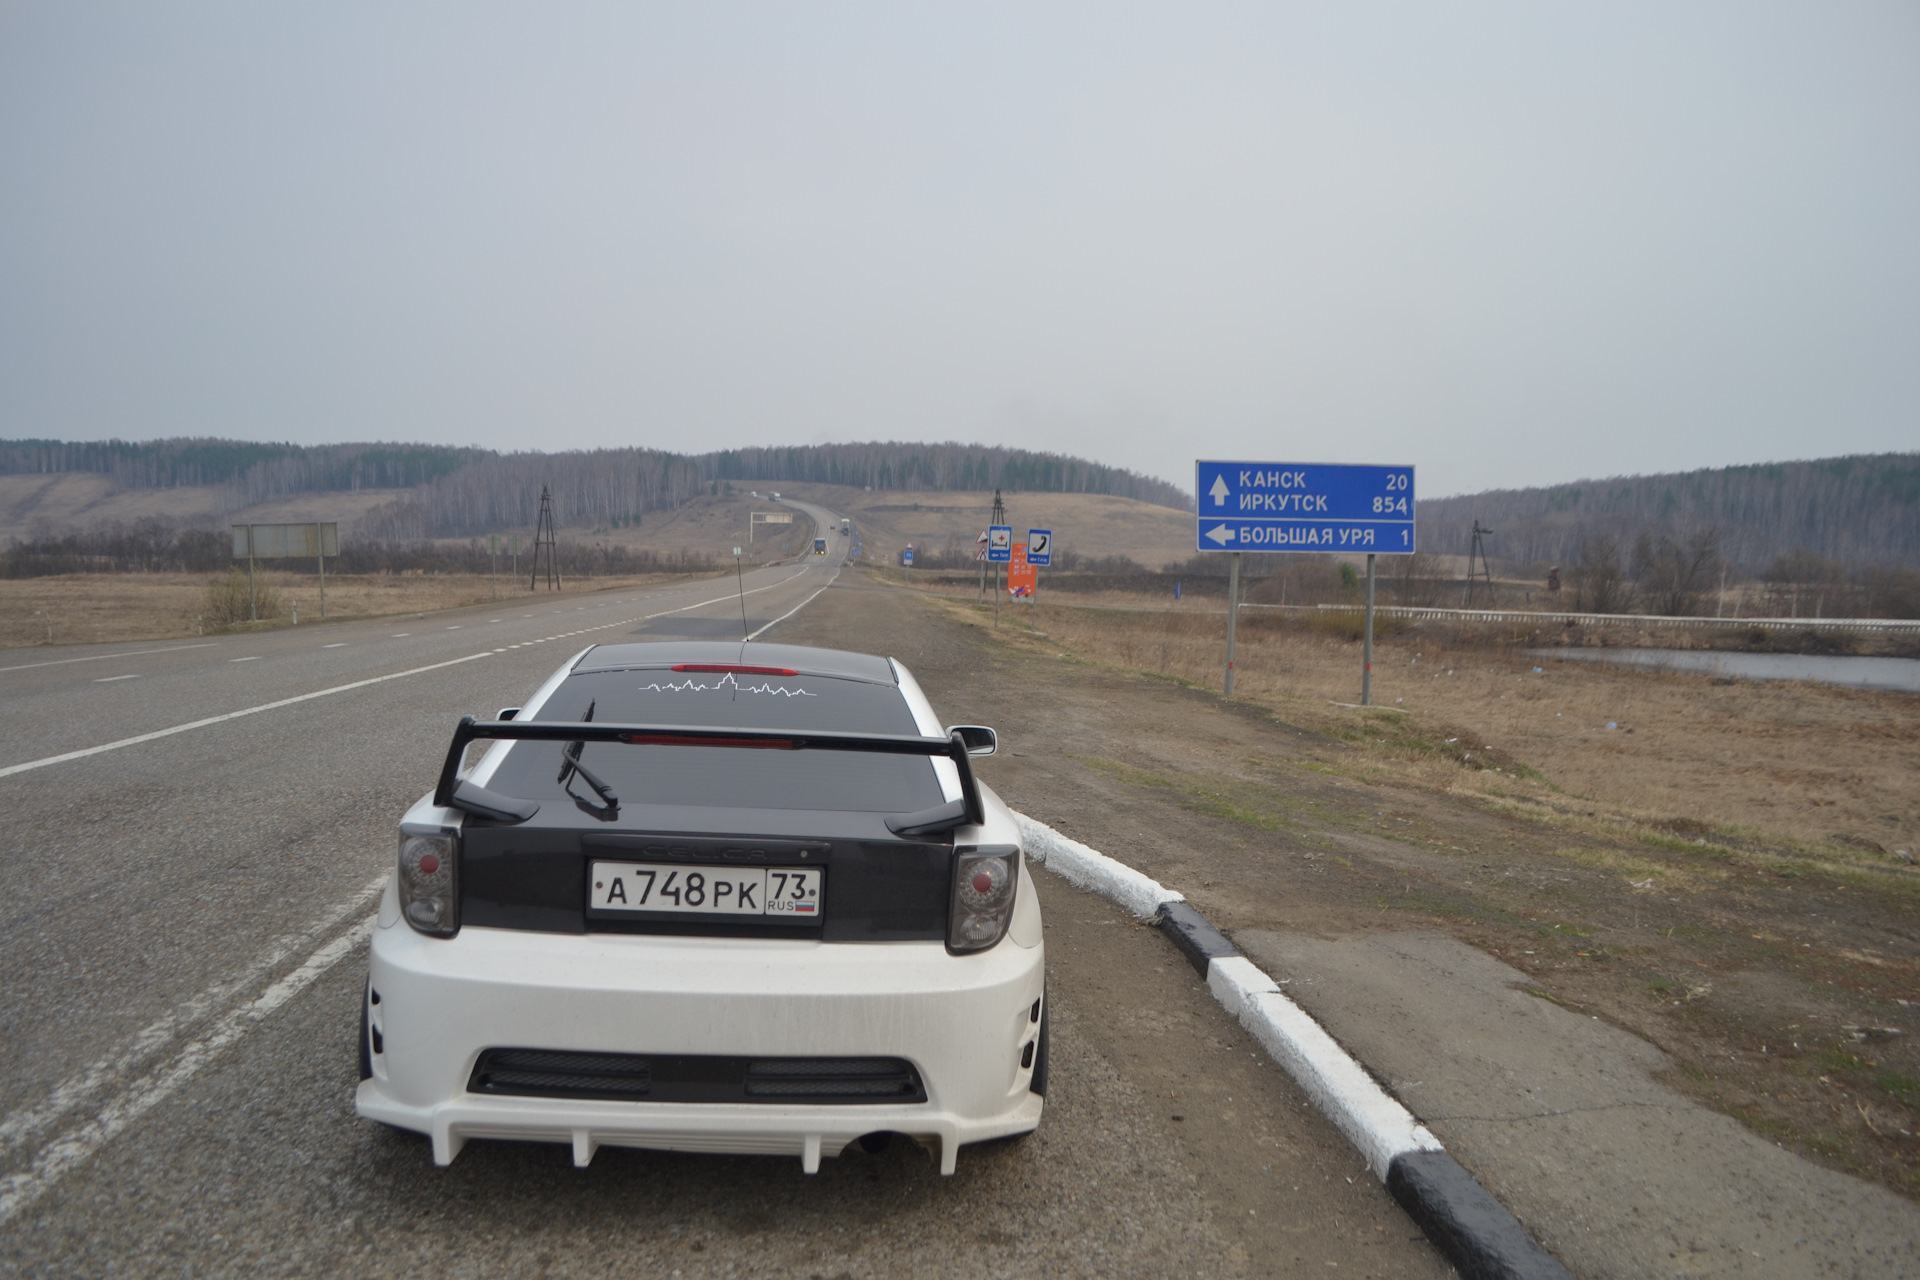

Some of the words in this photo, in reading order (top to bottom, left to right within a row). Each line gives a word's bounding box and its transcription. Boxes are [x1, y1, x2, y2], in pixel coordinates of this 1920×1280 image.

[1239, 470, 1306, 488] КАНСК
[1386, 474, 1408, 490] 20
[1239, 493, 1328, 511] ИРКУТСК
[1372, 496, 1408, 514] 854
[1240, 526, 1333, 544] БОЛЬШАЯ
[1339, 528, 1375, 545] УРЯ
[1401, 529, 1409, 546] 1
[642, 845, 768, 860] CELICA
[771, 873, 807, 900] 73
[767, 900, 794, 912] RUS
